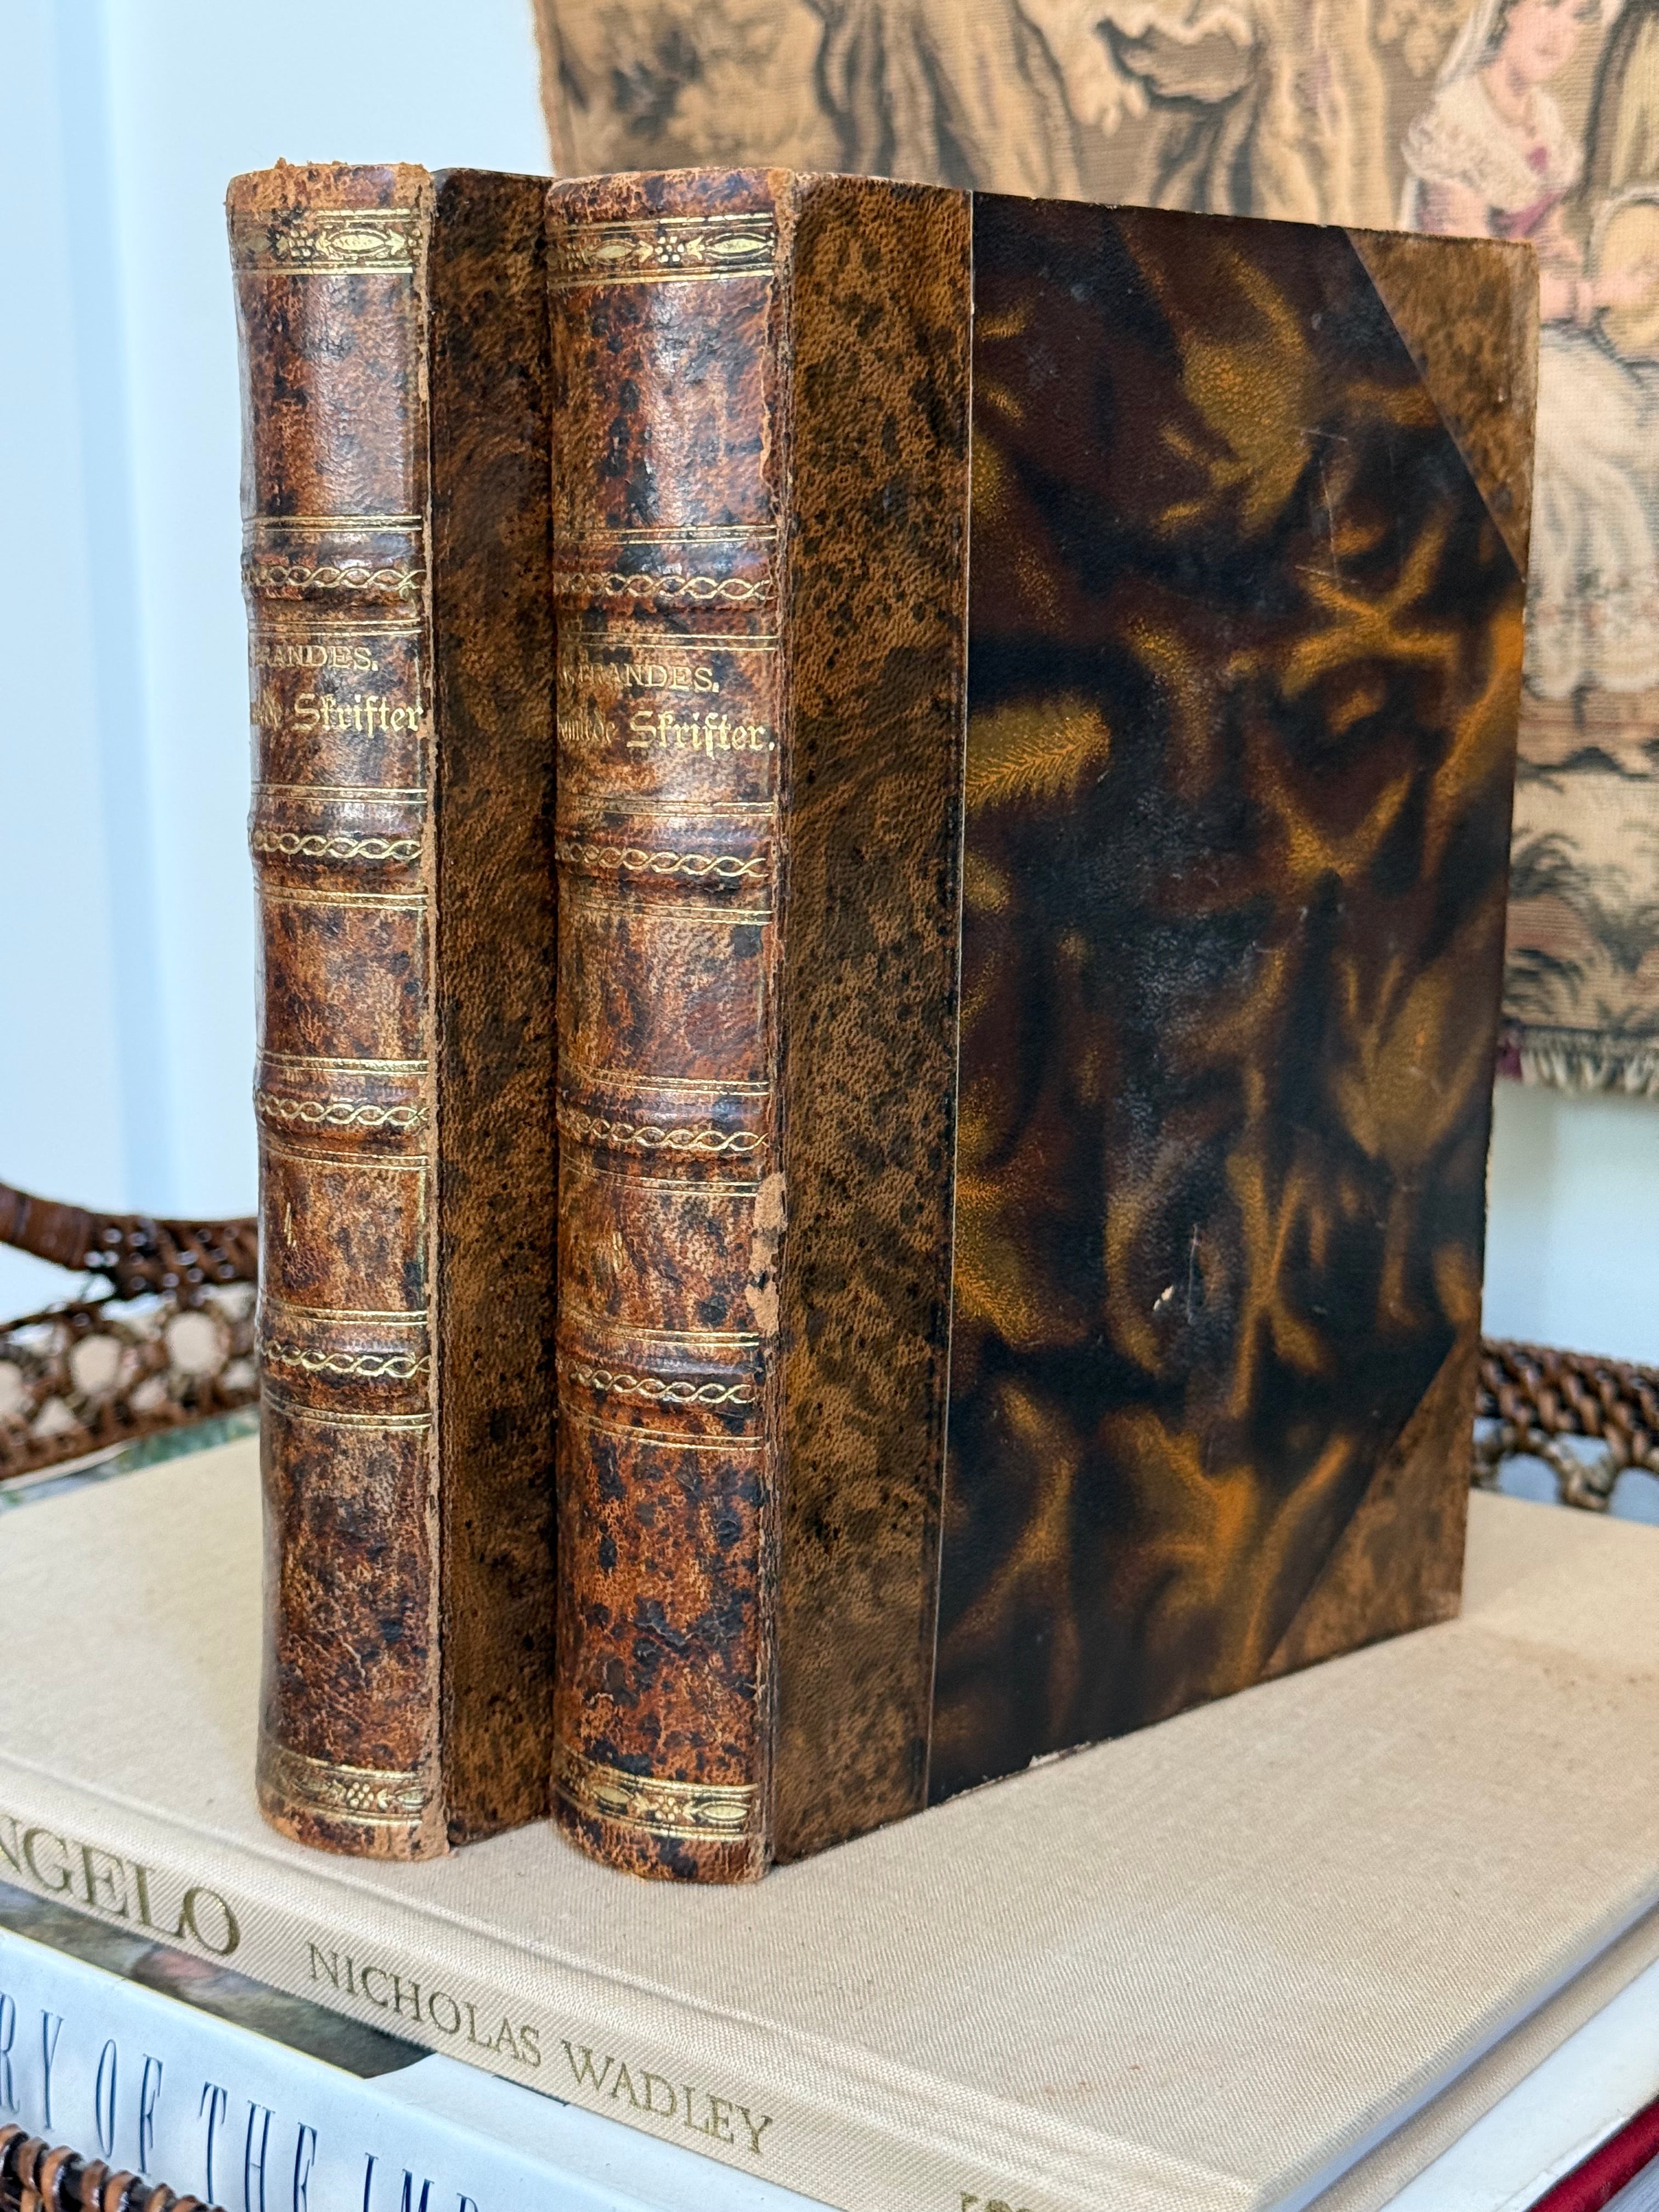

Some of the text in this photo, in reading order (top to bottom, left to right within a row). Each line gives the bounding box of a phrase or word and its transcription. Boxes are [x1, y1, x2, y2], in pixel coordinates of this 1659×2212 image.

[95, 2039, 163, 2176] OF
[198, 2081, 318, 2212] THE
[306, 1942, 542, 2068] NICHOLAS
[560, 2039, 773, 2154] WADLEY
